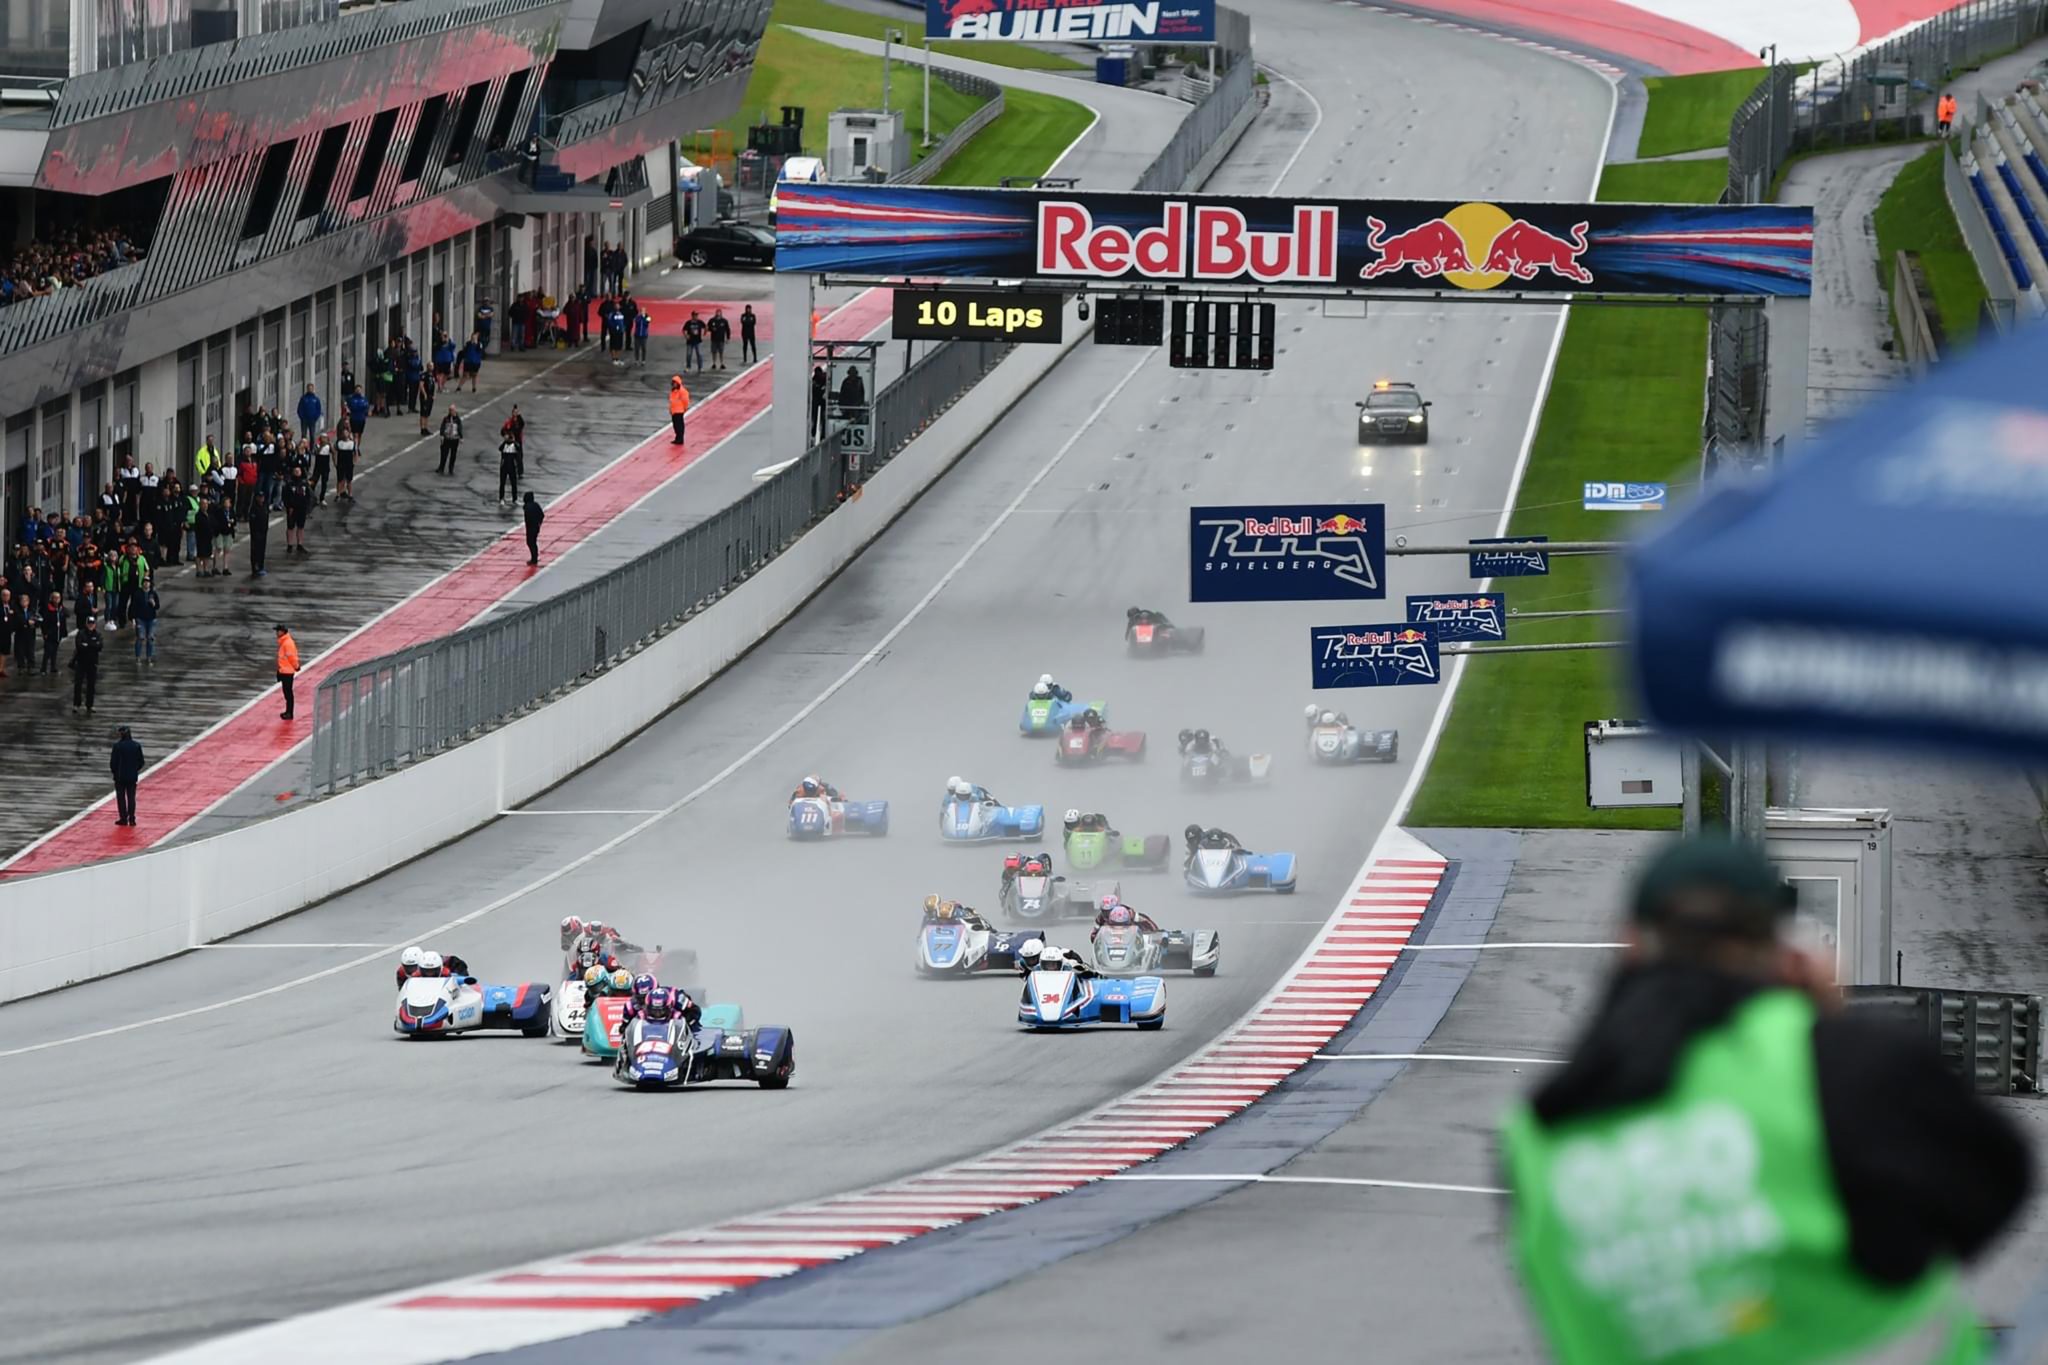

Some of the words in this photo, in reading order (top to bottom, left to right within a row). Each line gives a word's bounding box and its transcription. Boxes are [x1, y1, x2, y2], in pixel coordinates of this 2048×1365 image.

[1037, 201, 1188, 278] Red
[1193, 205, 1339, 283] Bull
[918, 301, 957, 326] 10
[968, 302, 1043, 333] Laps
[1245, 516, 1279, 536] Red
[1279, 516, 1313, 535] Bull
[1205, 560, 1331, 571] SPIELBERG
[1346, 632, 1369, 645] Red
[1369, 631, 1392, 644] Bull
[1867, 842, 1877, 851] 19
[1041, 993, 1060, 1004] 34
